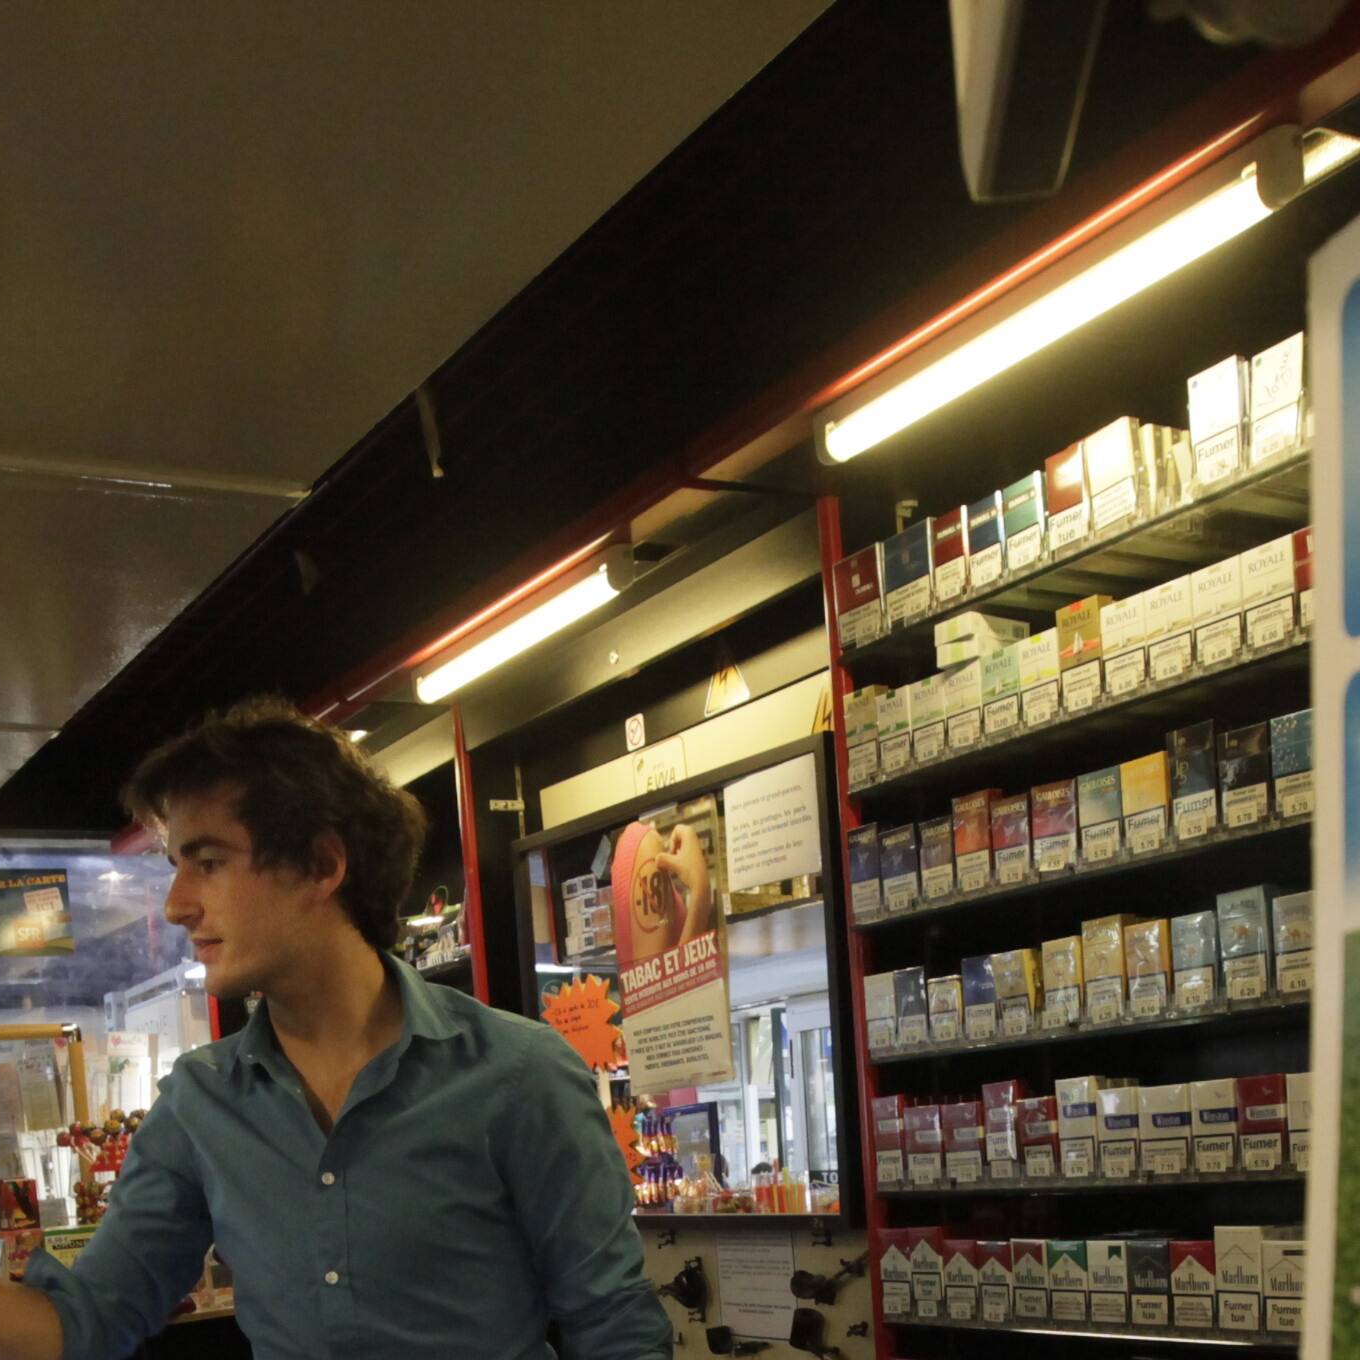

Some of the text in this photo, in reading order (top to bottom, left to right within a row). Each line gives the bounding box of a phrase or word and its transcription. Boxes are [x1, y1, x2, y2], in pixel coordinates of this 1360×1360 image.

[1197, 437, 1235, 460] Fumer
[1049, 510, 1084, 529] Fumer
[1058, 526, 1076, 542] tue
[1248, 553, 1286, 574] ROYALE
[1197, 573, 1233, 593] ROYALE
[1150, 591, 1183, 611] ROYALE
[1062, 611, 1091, 628] ROYALE
[1105, 607, 1138, 624] ROYALE
[985, 657, 1013, 674] ROYALE
[1174, 795, 1214, 815] Fumer
[1127, 813, 1161, 831] Fumer
[1084, 825, 1116, 841] Fumer
[620, 931, 718, 994] TABAC ET JEUX
[1196, 1140, 1231, 1152] Fumer
[1242, 1137, 1280, 1150] Fumer
[1174, 1273, 1211, 1292] Marlboro
[1221, 1265, 1259, 1285] Marlboro
[1136, 1298, 1163, 1310] Fumer
[1224, 1300, 1252, 1312] Fumer
[1271, 1303, 1303, 1315] Fumer
[1142, 1310, 1156, 1320] tue
[1230, 1312, 1246, 1323] tue
[1279, 1316, 1295, 1327] tue
